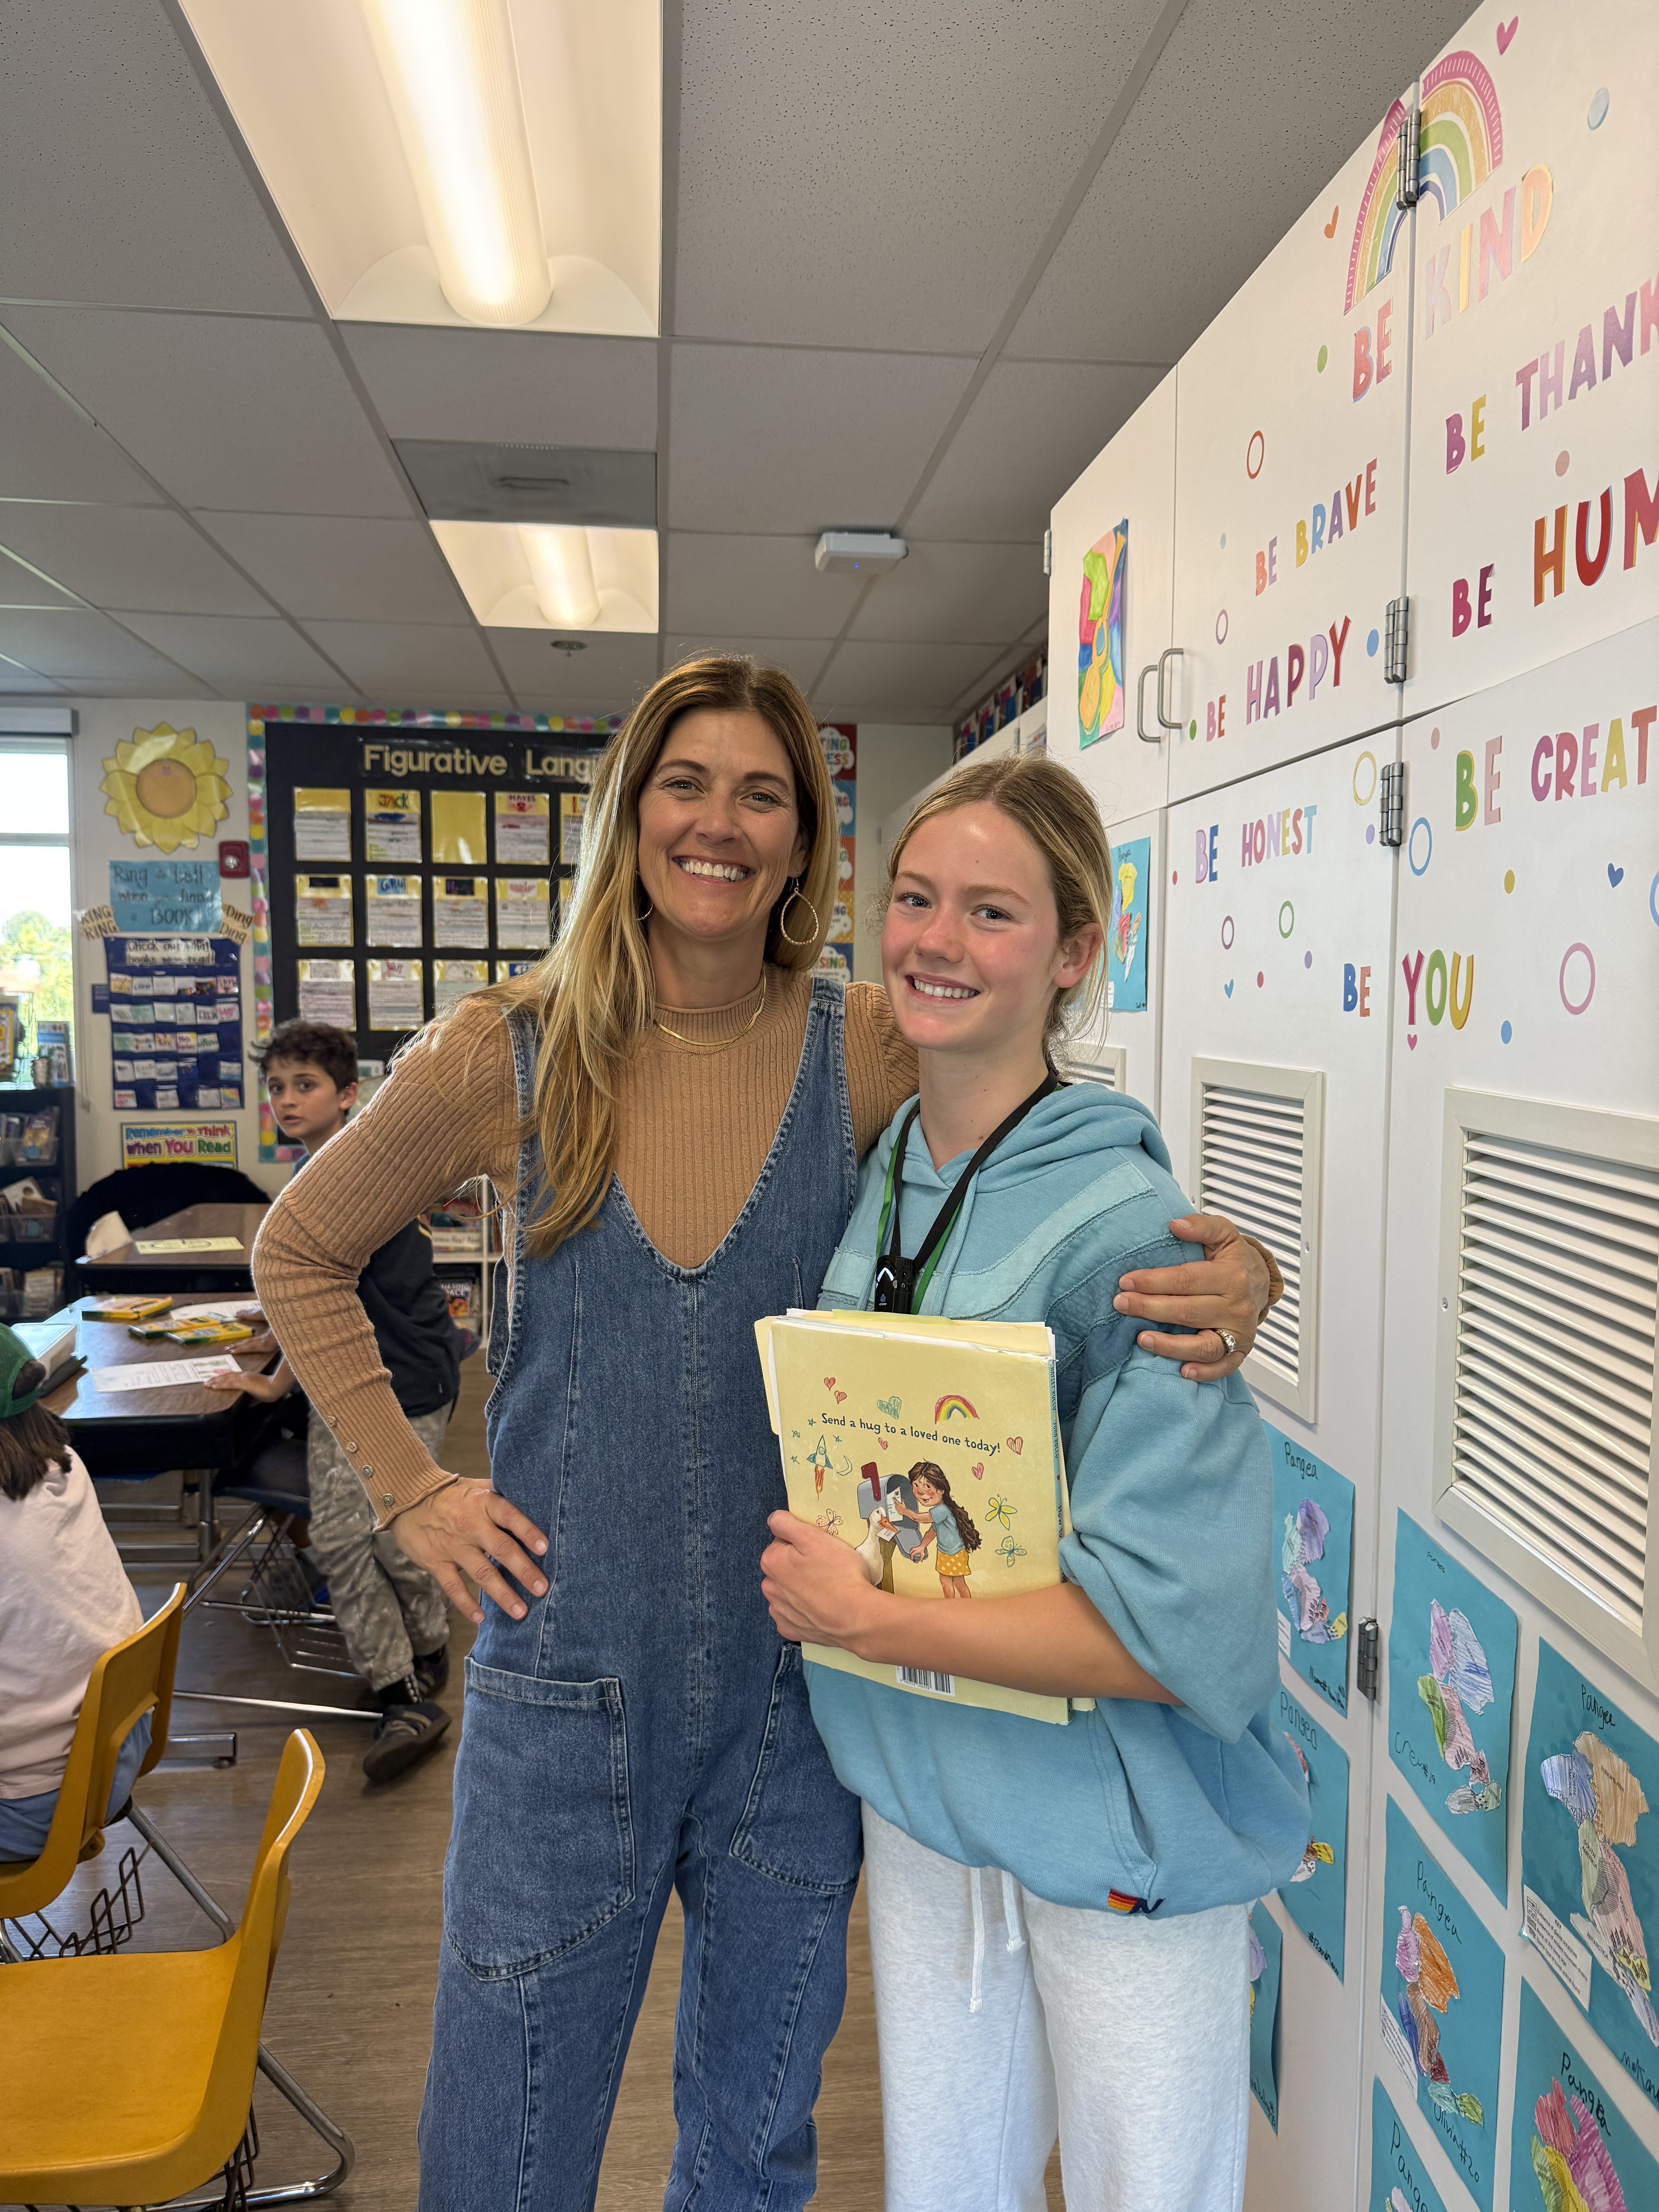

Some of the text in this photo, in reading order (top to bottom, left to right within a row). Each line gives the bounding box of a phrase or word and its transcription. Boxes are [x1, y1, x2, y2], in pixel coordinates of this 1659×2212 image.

[1352, 164, 1553, 404] BE KIND
[1445, 394, 1486, 474] BE
[1255, 457, 1377, 596] BE BRAVE
[1452, 468, 1659, 637] BE HUM
[1206, 615, 1352, 742] BE HAPPY
[364, 744, 508, 778] Figurative
[1455, 705, 1657, 831] BE CREAT
[1195, 805, 1317, 884] BE HONEST
[1343, 949, 1474, 1030] BE YOU
[127, 1139, 231, 1155] when YOU Read
[198, 1125, 231, 1137] Think
[821, 1413, 846, 1426] Send
[860, 1419, 881, 1434] hug
[884, 1423, 896, 1434] to
[910, 1426, 938, 1441] loved
[942, 1436, 961, 1446] one
[964, 1437, 1001, 1456] today!
[1285, 1441, 1318, 1480] Pangea
[1417, 1858, 1462, 1944] Pangea
